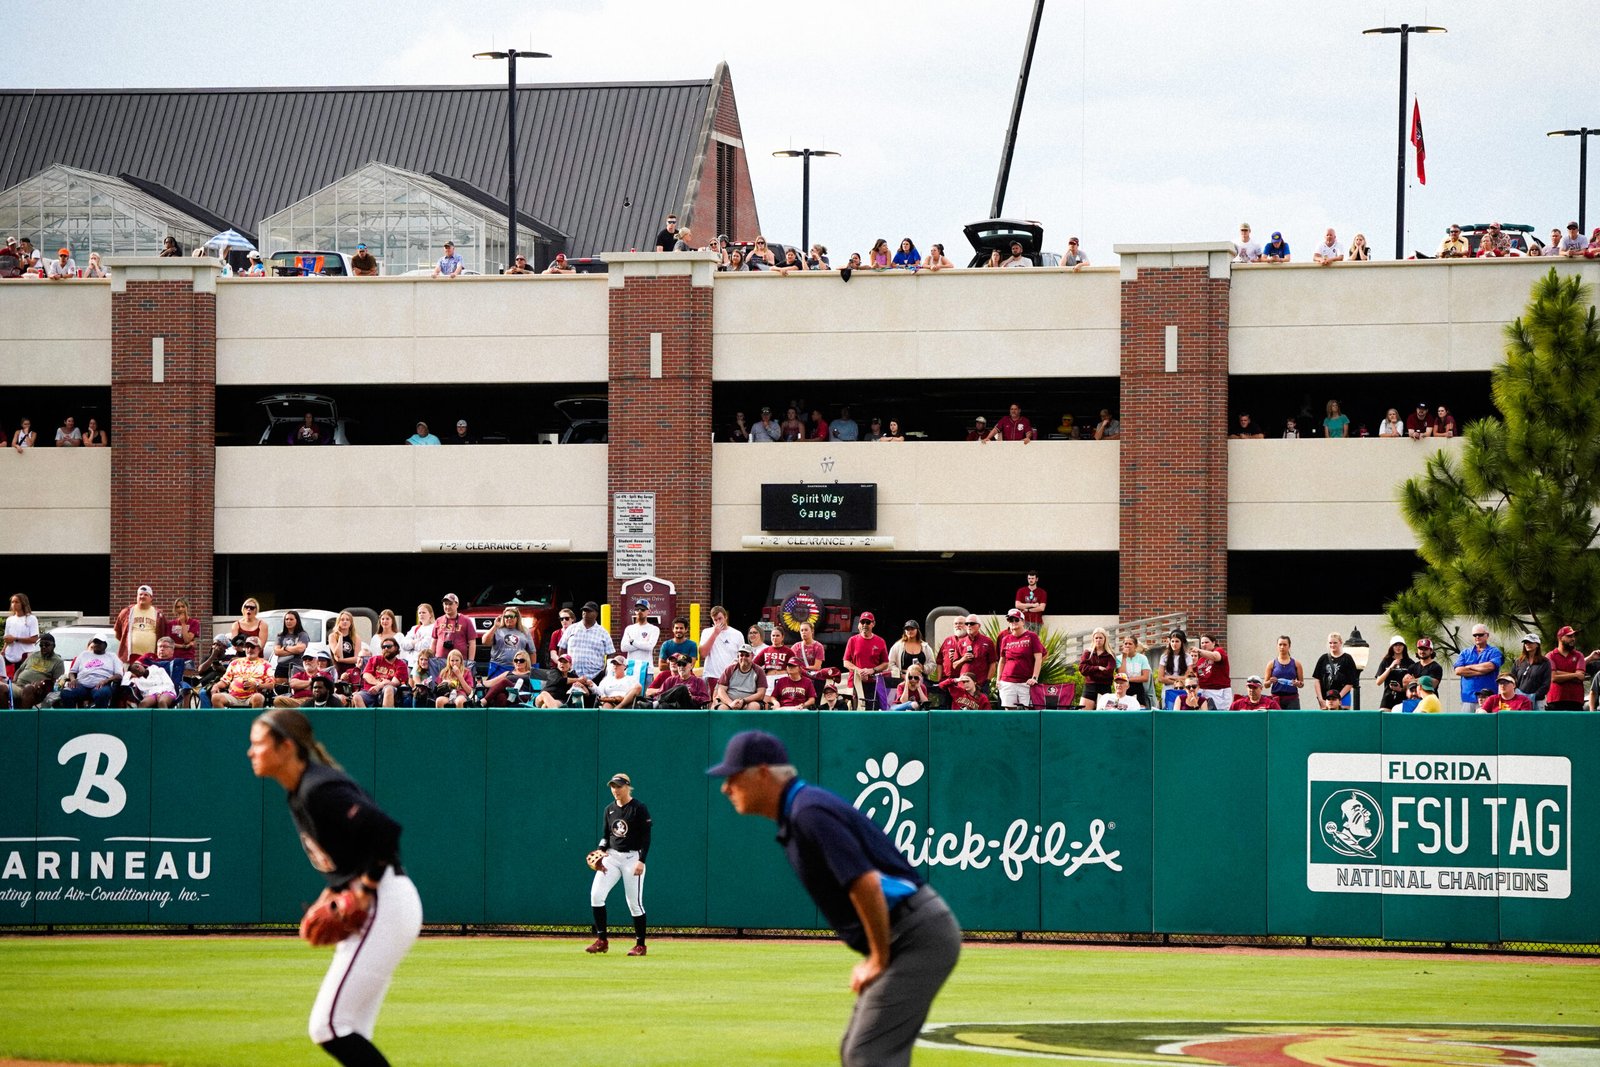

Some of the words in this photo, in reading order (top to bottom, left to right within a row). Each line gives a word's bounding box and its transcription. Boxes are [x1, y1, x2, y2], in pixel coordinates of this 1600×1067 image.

[791, 494, 819, 505] Spirit
[821, 494, 845, 505] Way
[799, 509, 837, 520] Garage
[465, 542, 523, 550] CLEARANCE
[787, 537, 845, 546] CLEARANCE
[764, 652, 787, 662] FSU
[57, 733, 128, 818] B
[1388, 761, 1492, 782] FLORIDA
[1391, 796, 1470, 855] FSU
[1483, 797, 1561, 857] TAG
[1336, 867, 1432, 889] NATIONAL
[1438, 870, 1549, 892] CHAMPIONS
[35, 886, 63, 902] and
